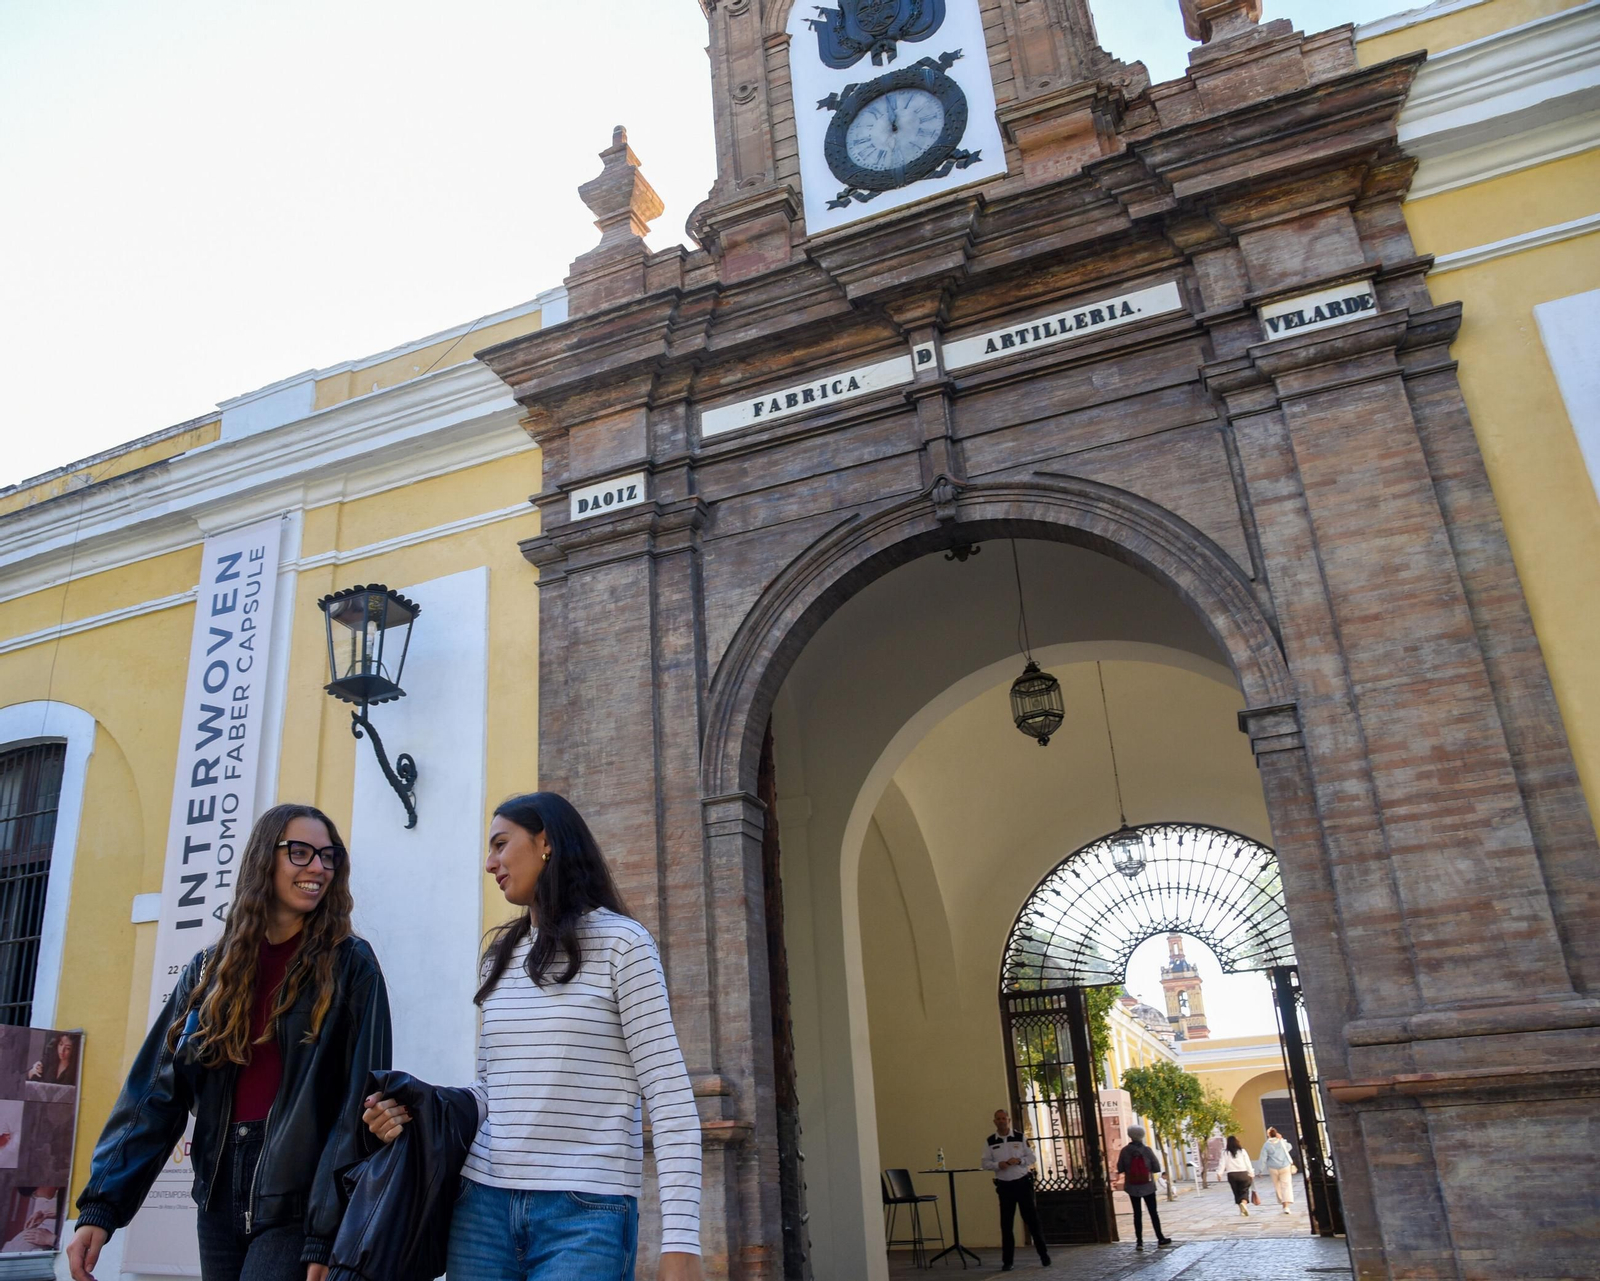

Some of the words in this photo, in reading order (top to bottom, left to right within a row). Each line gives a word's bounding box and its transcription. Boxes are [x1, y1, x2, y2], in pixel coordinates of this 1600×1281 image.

[753, 375, 860, 418] FABRICA
[984, 300, 1142, 354] ARTILLERIA.
[1265, 293, 1375, 333] VELARDE
[577, 484, 637, 514] DAOIZ
[236, 545, 265, 673] CAPSULE
[175, 551, 243, 930] INTERWOVEN
[224, 683, 250, 780] FABER
[215, 793, 239, 889] HOMO
[213, 901, 229, 922] A
[168, 965, 179, 975] 22
